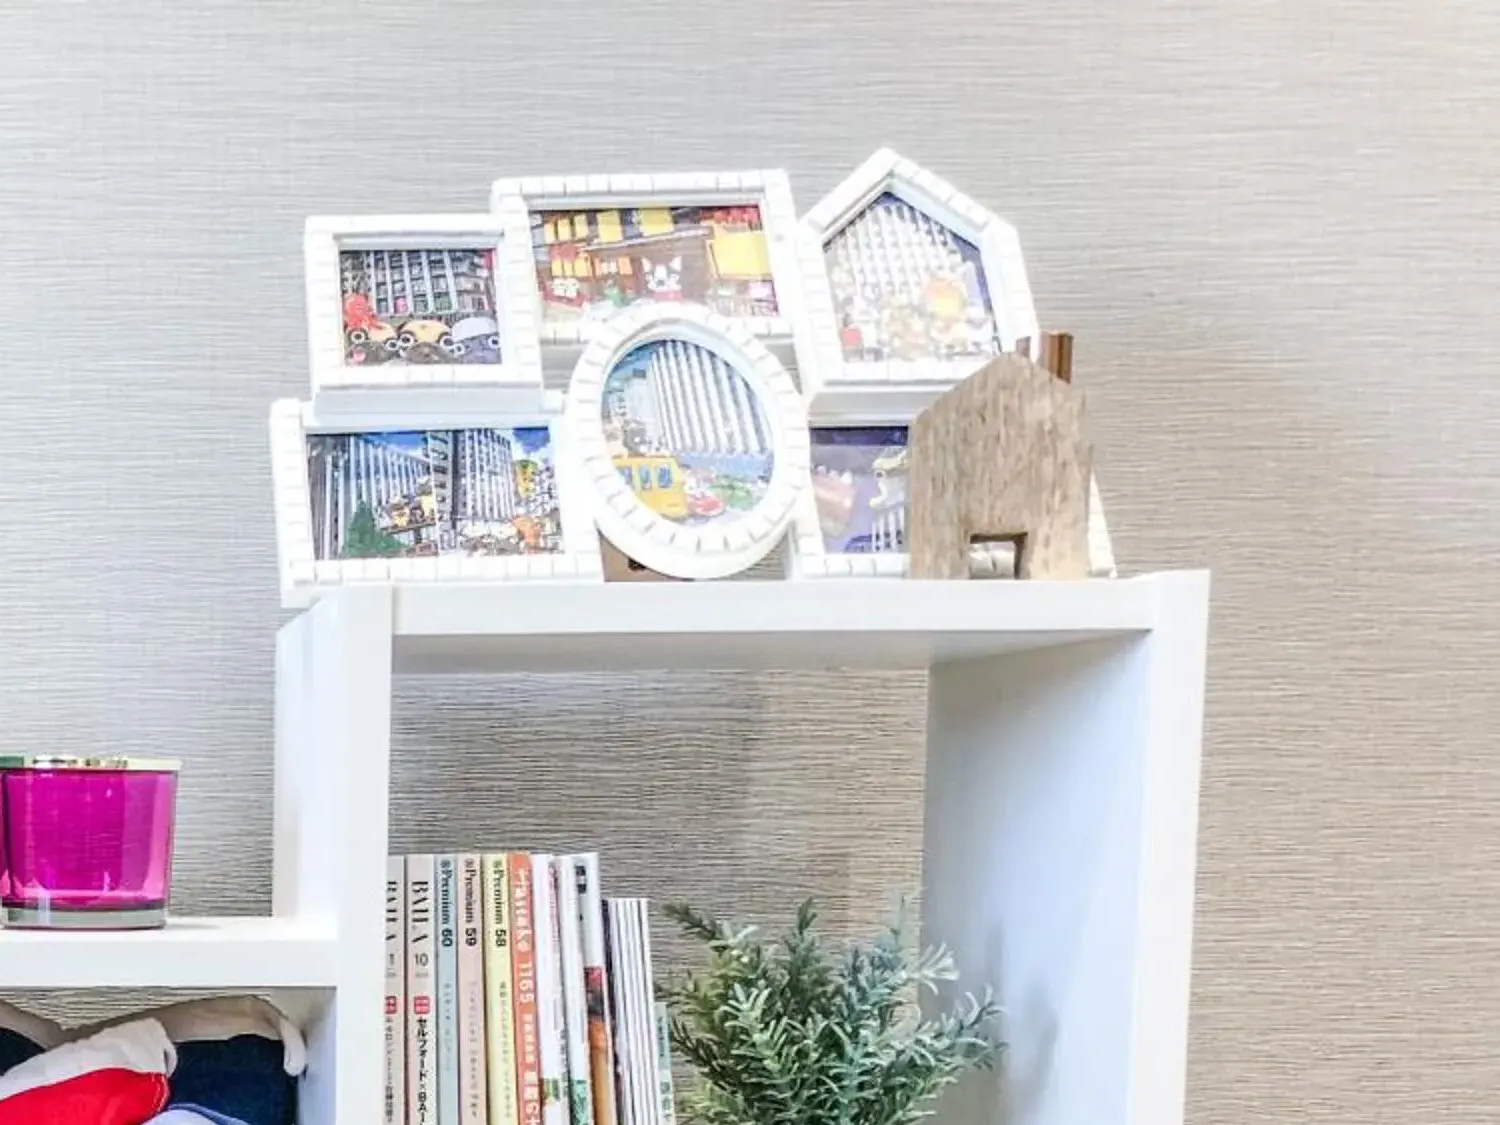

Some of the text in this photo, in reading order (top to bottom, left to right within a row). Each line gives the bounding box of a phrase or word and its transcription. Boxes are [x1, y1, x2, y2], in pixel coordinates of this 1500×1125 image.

[411, 881, 429, 942] BAILA
[441, 928, 453, 947] 60
[465, 928, 477, 947] 59
[495, 929, 507, 947] 58
[414, 952, 429, 967] 10
[518, 959, 534, 1004] 1165
